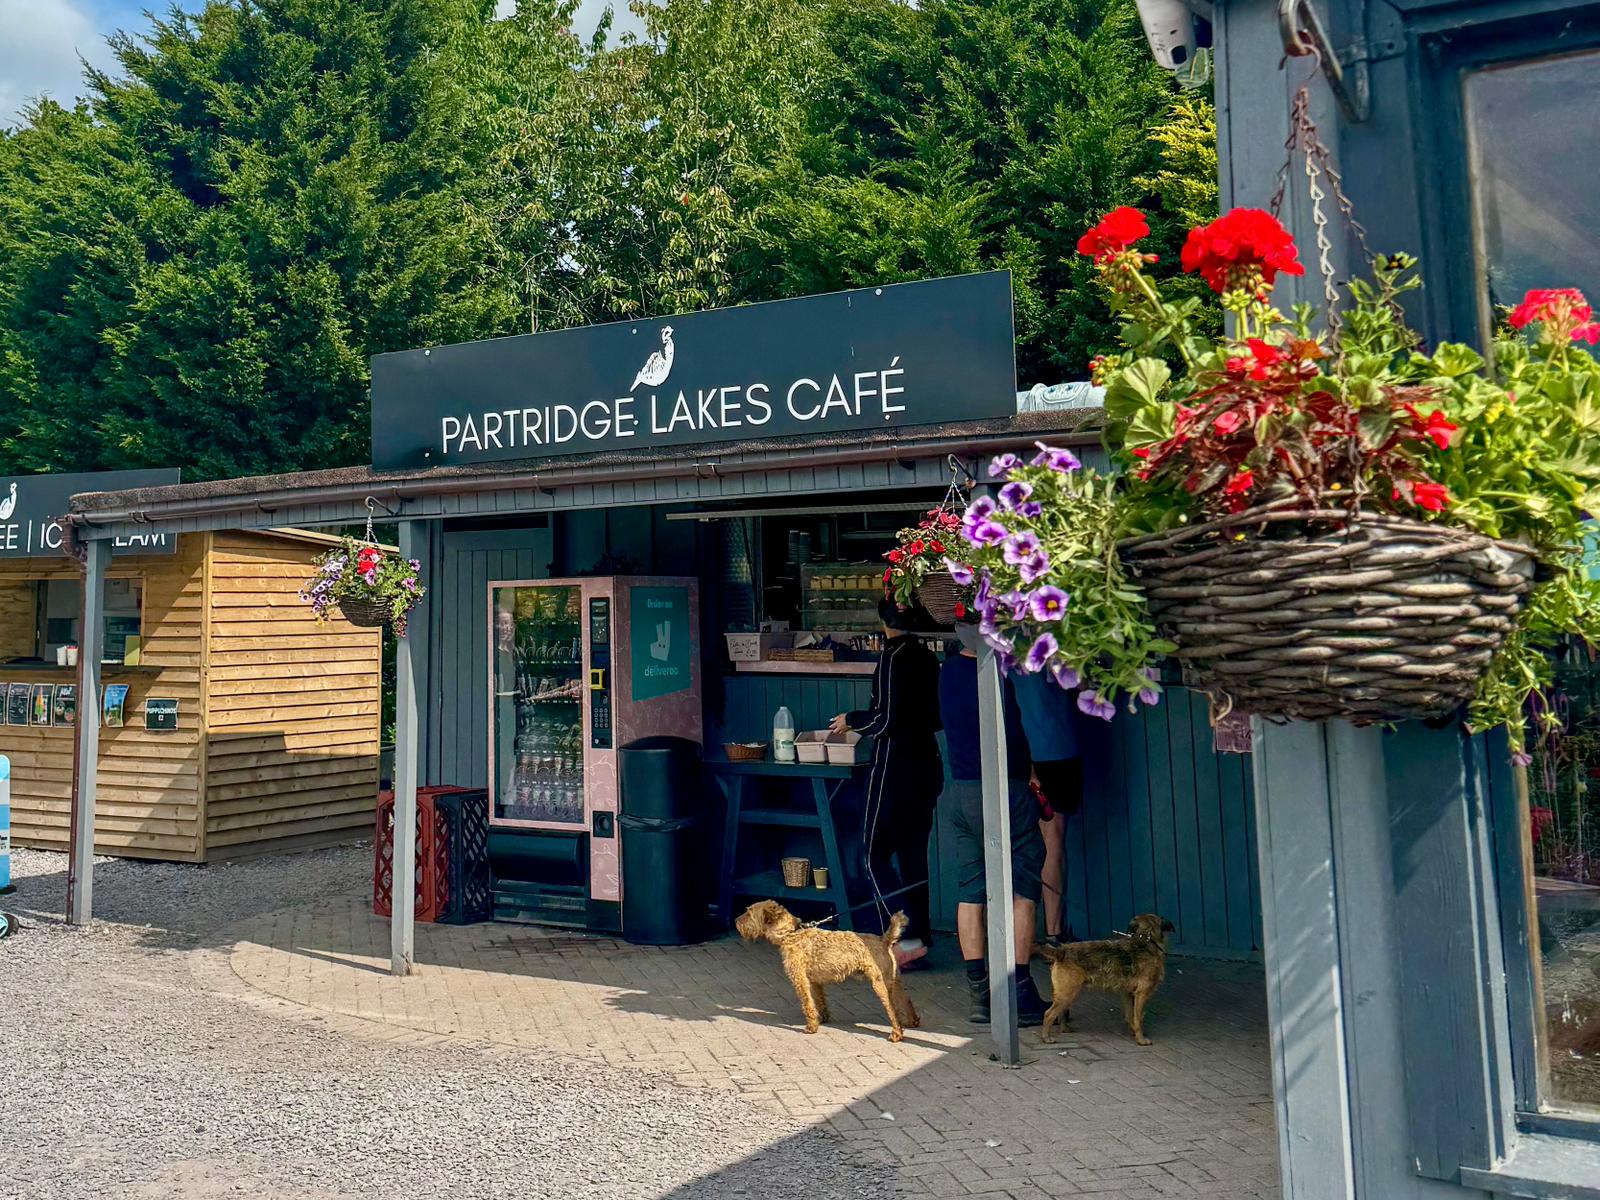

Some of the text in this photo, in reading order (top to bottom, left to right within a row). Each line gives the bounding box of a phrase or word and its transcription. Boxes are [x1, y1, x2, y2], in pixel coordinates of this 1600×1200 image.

[442, 356, 906, 454] PARTRIDGE LAKES CAFÉ
[40, 522, 63, 549] IC
[644, 665, 678, 676] deliveroo
